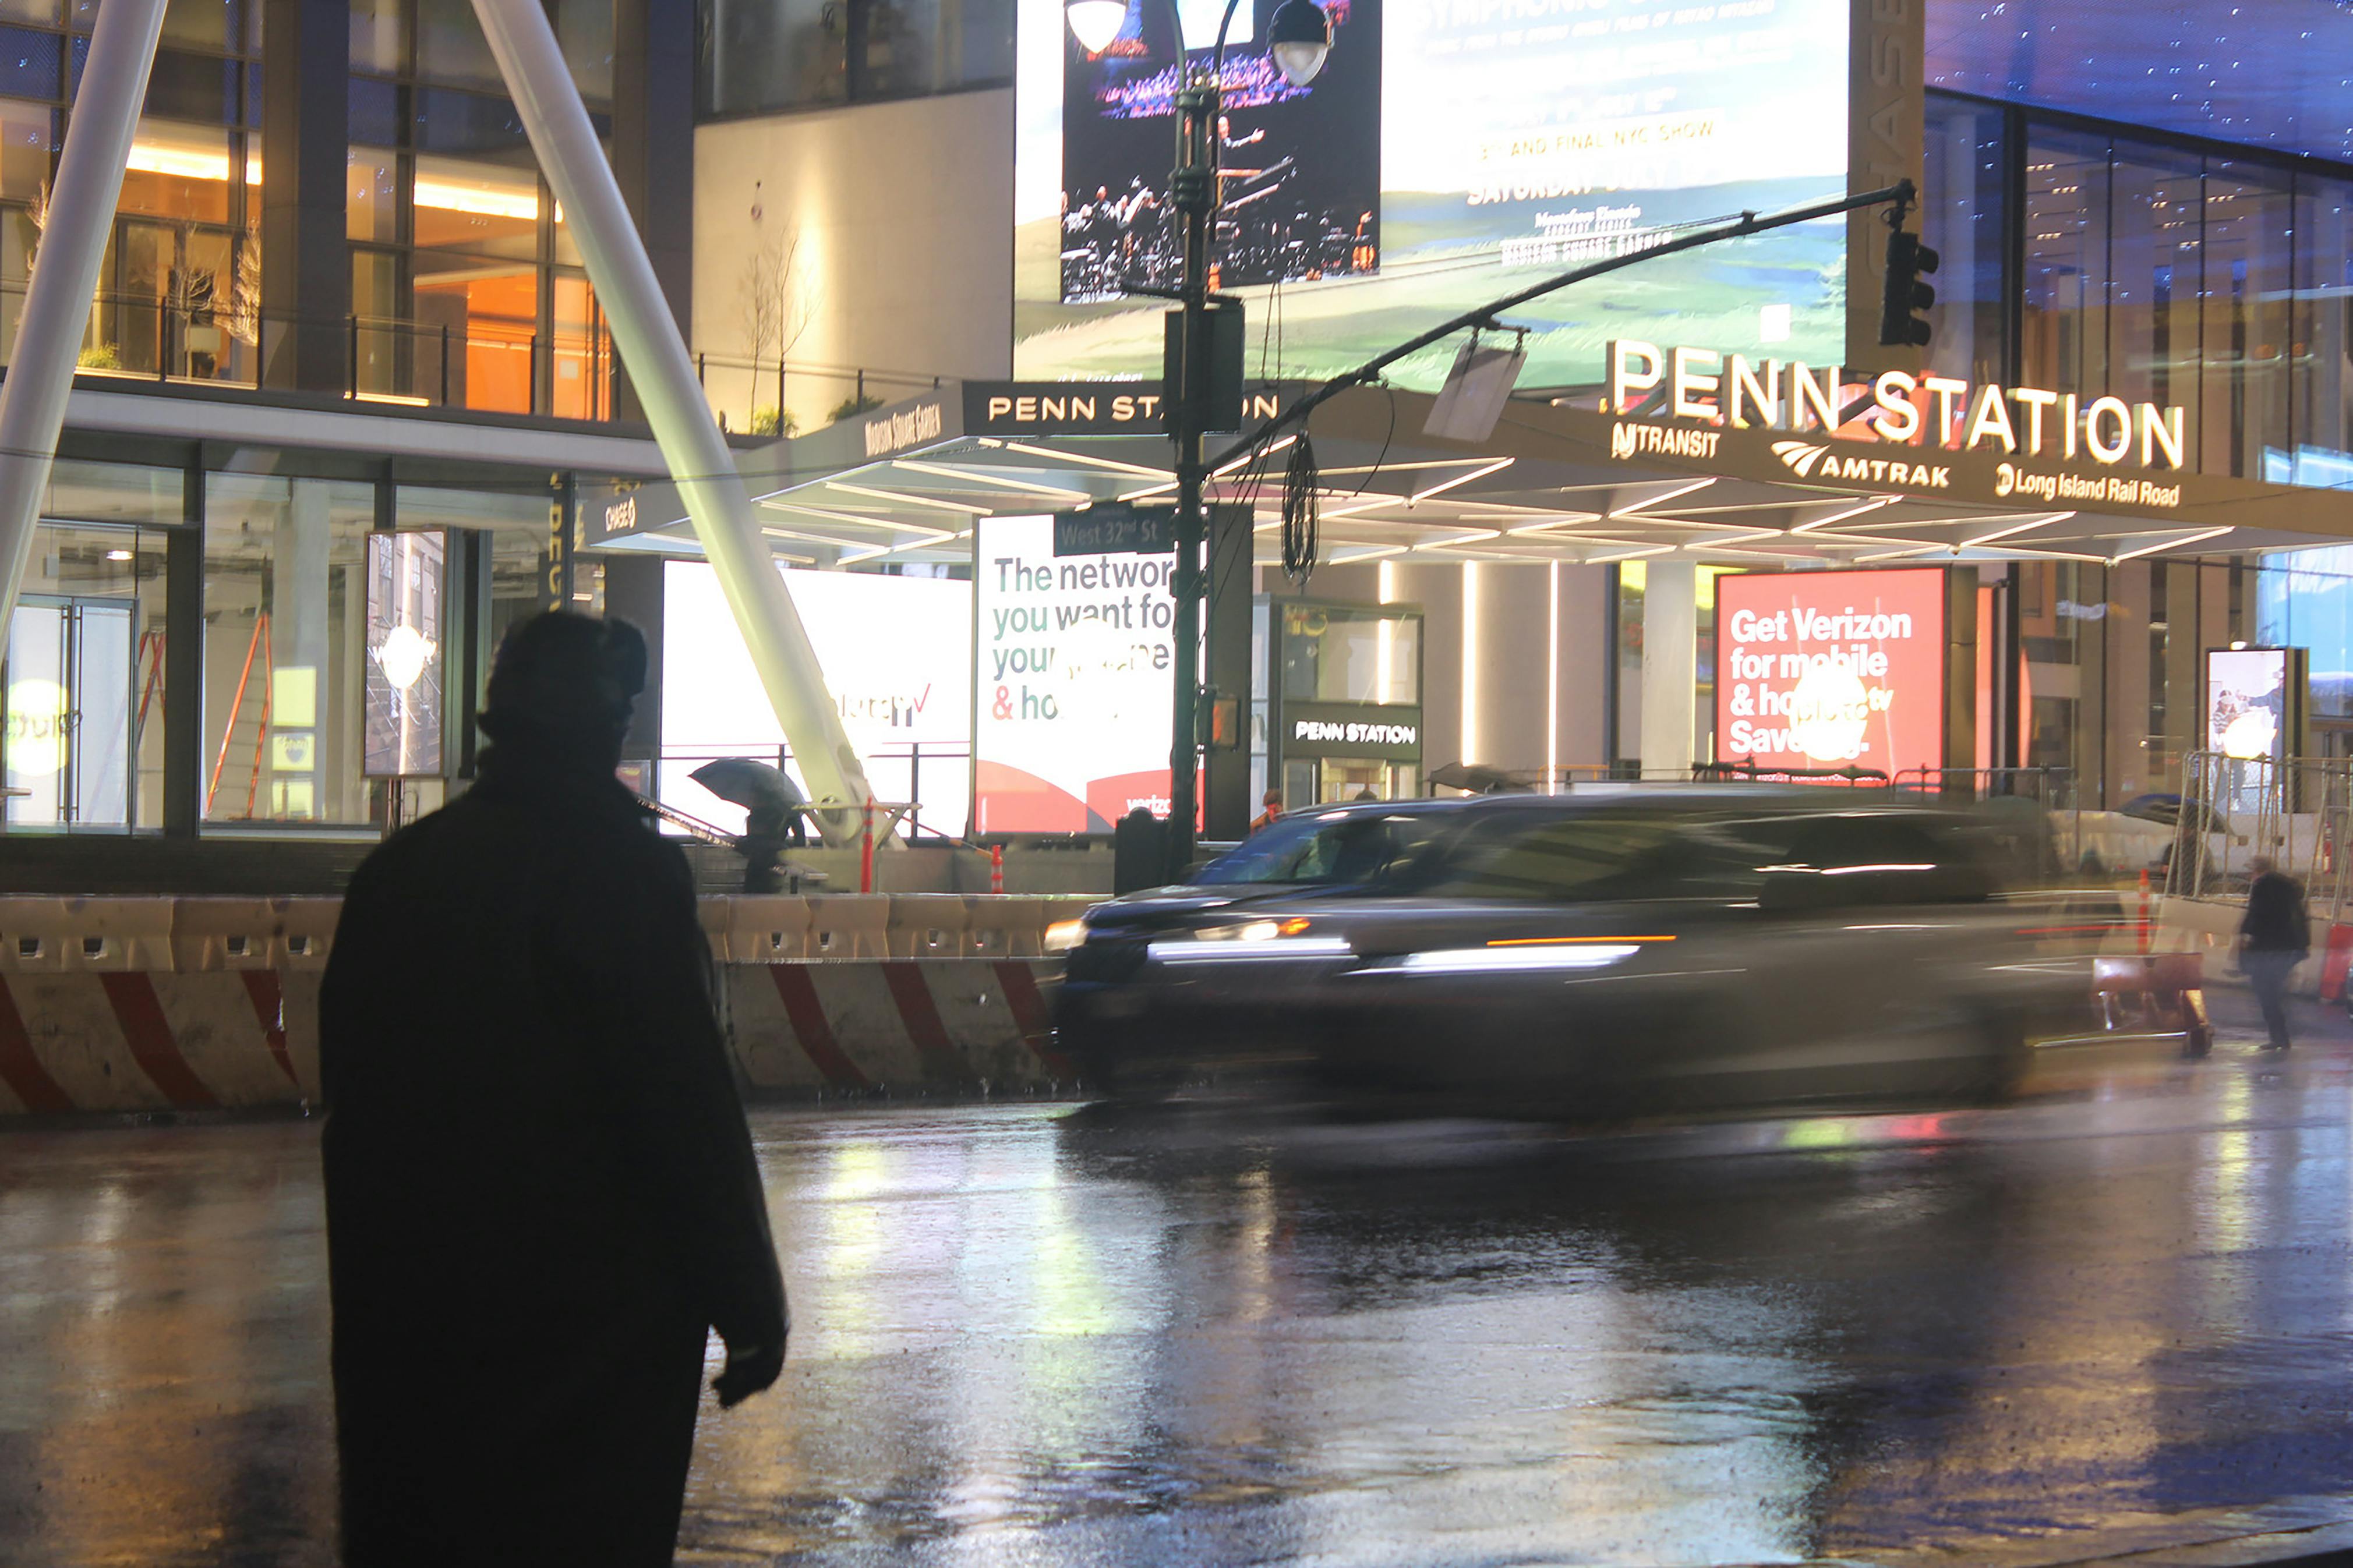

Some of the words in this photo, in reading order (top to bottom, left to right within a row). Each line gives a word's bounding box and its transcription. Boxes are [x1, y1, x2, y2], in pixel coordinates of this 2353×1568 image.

[1510, 137, 1548, 157] AND
[1556, 130, 1606, 151] FINAL
[1613, 125, 1649, 147] NYC
[1658, 119, 1715, 142] SHOW
[989, 395, 1096, 421] PENN
[1606, 338, 1840, 433] PENN
[1870, 370, 2184, 470] STATION
[1637, 424, 1720, 459] TRANSIT
[1819, 455, 1951, 488] AMTRAK
[2016, 468, 2057, 502] Long
[2058, 472, 2107, 500] Island
[2107, 477, 2139, 502] Rail
[2139, 480, 2181, 507] Road
[1061, 523, 1100, 546] West
[1141, 518, 1158, 542] St
[994, 557, 1052, 592] The
[1059, 555, 1174, 590] networ
[992, 606, 1048, 641] you
[1055, 595, 1133, 631] want
[1139, 592, 1171, 629] fo
[1730, 609, 1788, 643] Get
[1792, 607, 1912, 641] Verizon
[1730, 646, 1776, 679] for
[1780, 643, 1889, 678] mobile
[992, 685, 1014, 720] &
[1730, 683, 1755, 717] &
[1296, 721, 1345, 742] PENN
[1345, 723, 1416, 745] STATION
[1126, 794, 1172, 814] veriz
